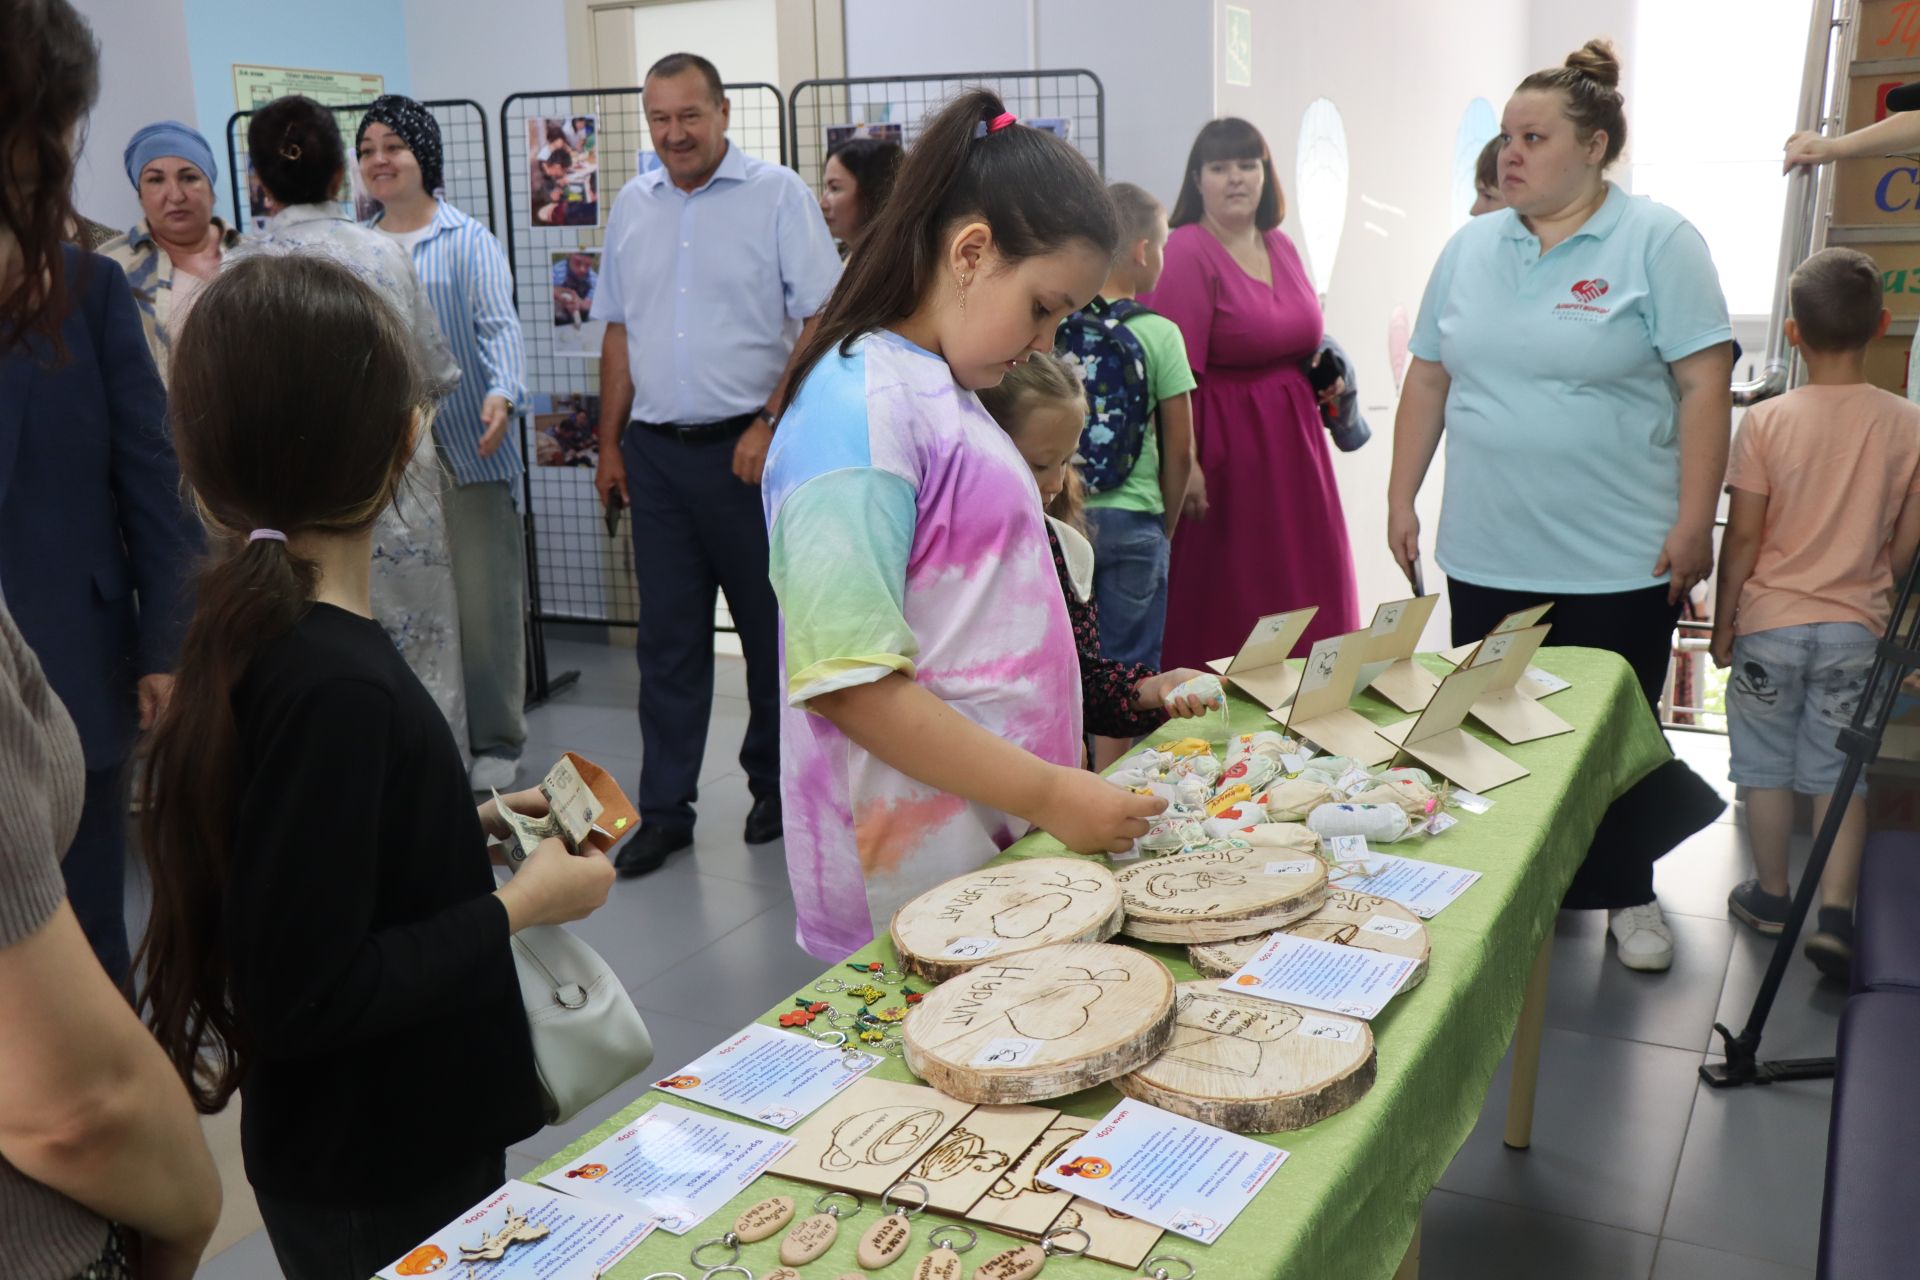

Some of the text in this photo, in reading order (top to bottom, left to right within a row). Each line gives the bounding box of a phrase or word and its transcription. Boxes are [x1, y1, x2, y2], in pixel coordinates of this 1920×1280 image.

[1040, 870, 1103, 893] Я
[1057, 965, 1132, 982] Я
[1110, 1110, 1131, 1124] цена
[730, 1139, 763, 1161] Брелок
[685, 1162, 736, 1198] деревянный
[485, 1192, 510, 1207] цена
